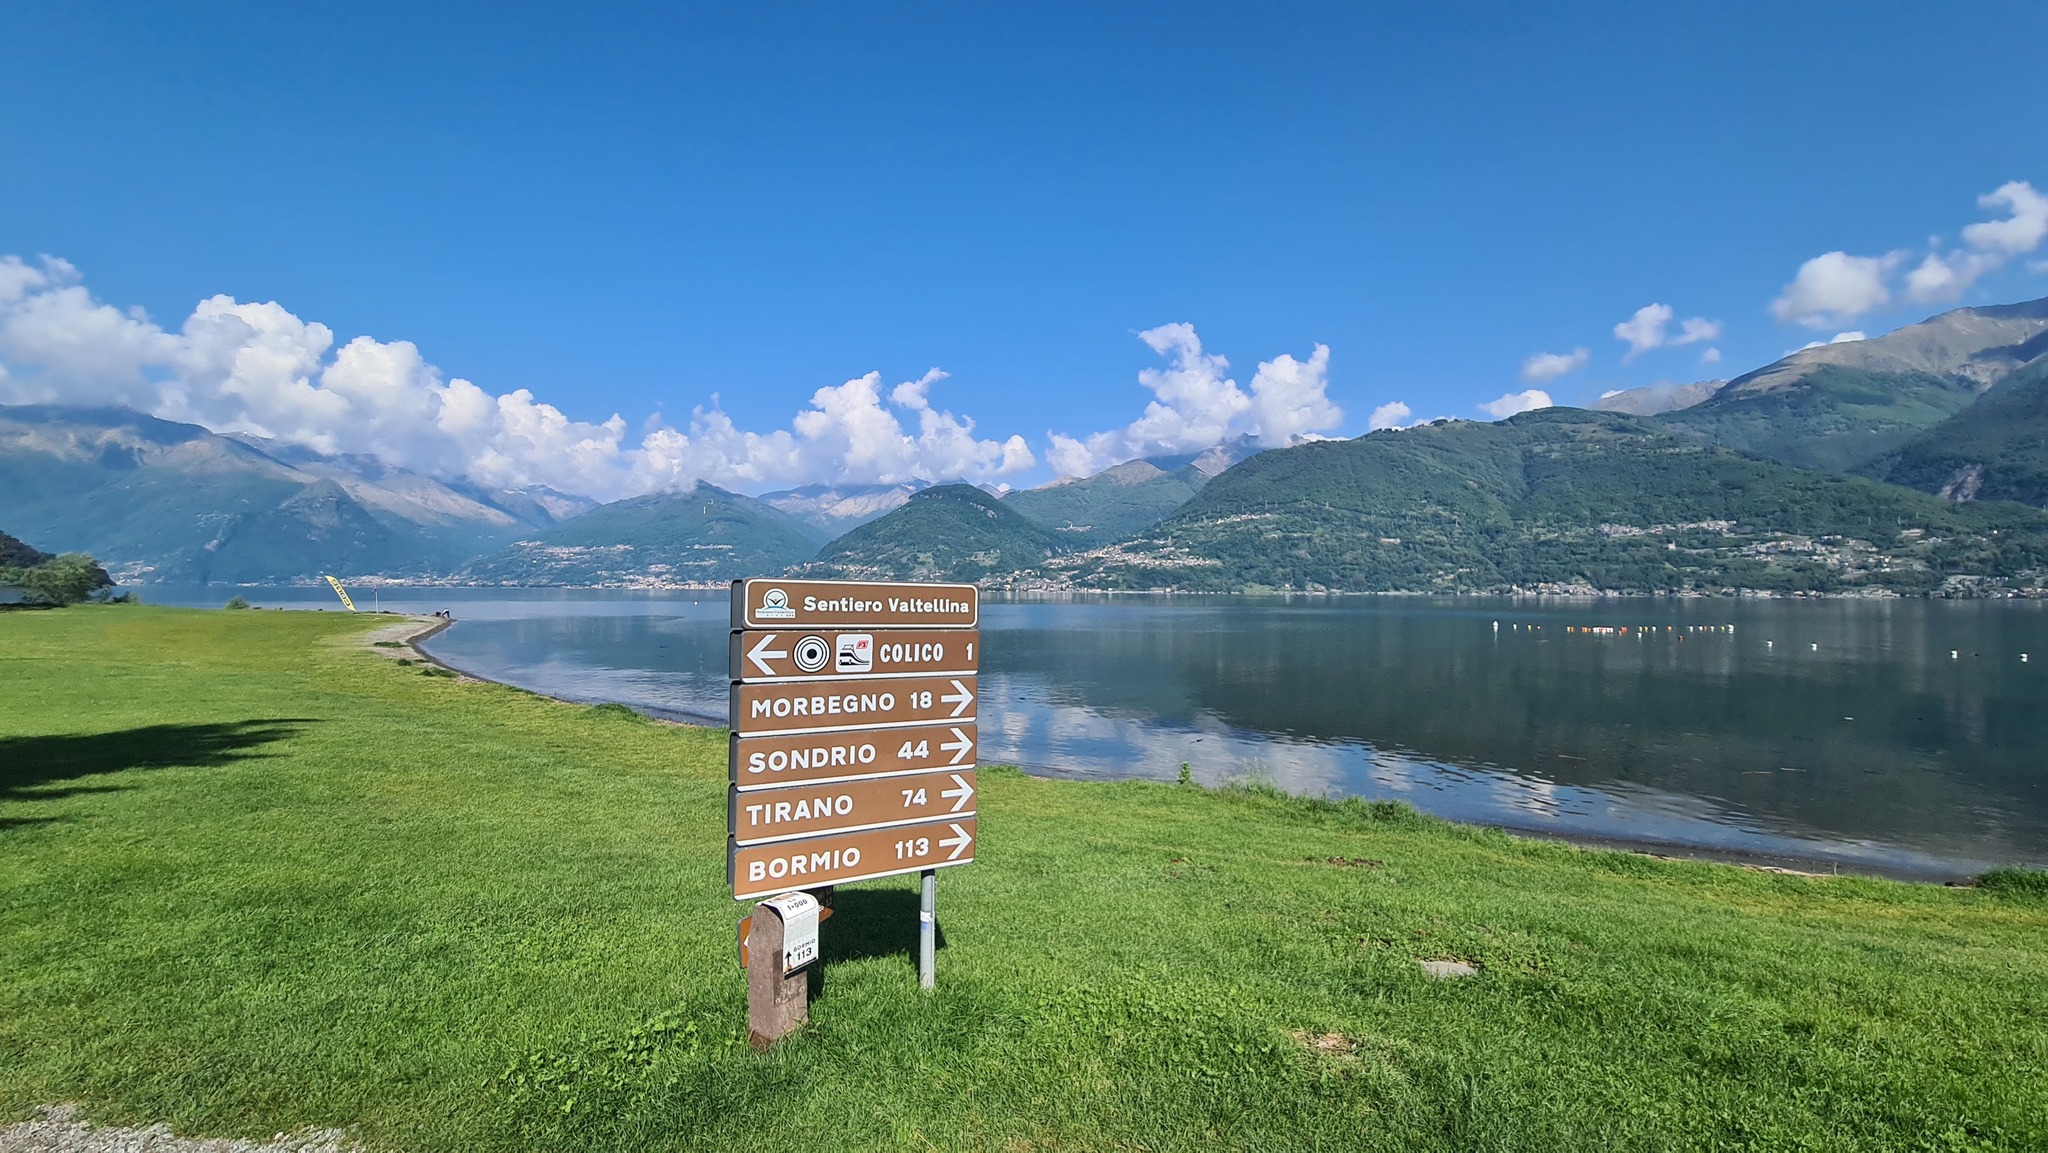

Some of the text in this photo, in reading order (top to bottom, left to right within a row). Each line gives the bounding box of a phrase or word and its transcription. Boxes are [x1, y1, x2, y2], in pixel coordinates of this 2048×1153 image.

[803, 596, 970, 614] Sentiero Valtellina
[879, 642, 973, 663] COLICO 1
[751, 691, 933, 719] MORBEGNO 18
[747, 739, 930, 774] SONDRIO 44
[745, 788, 928, 826] TIRANO 74
[748, 837, 930, 882] BORMIO 113
[793, 938, 816, 952] BORMIO
[796, 947, 812, 960] 113
